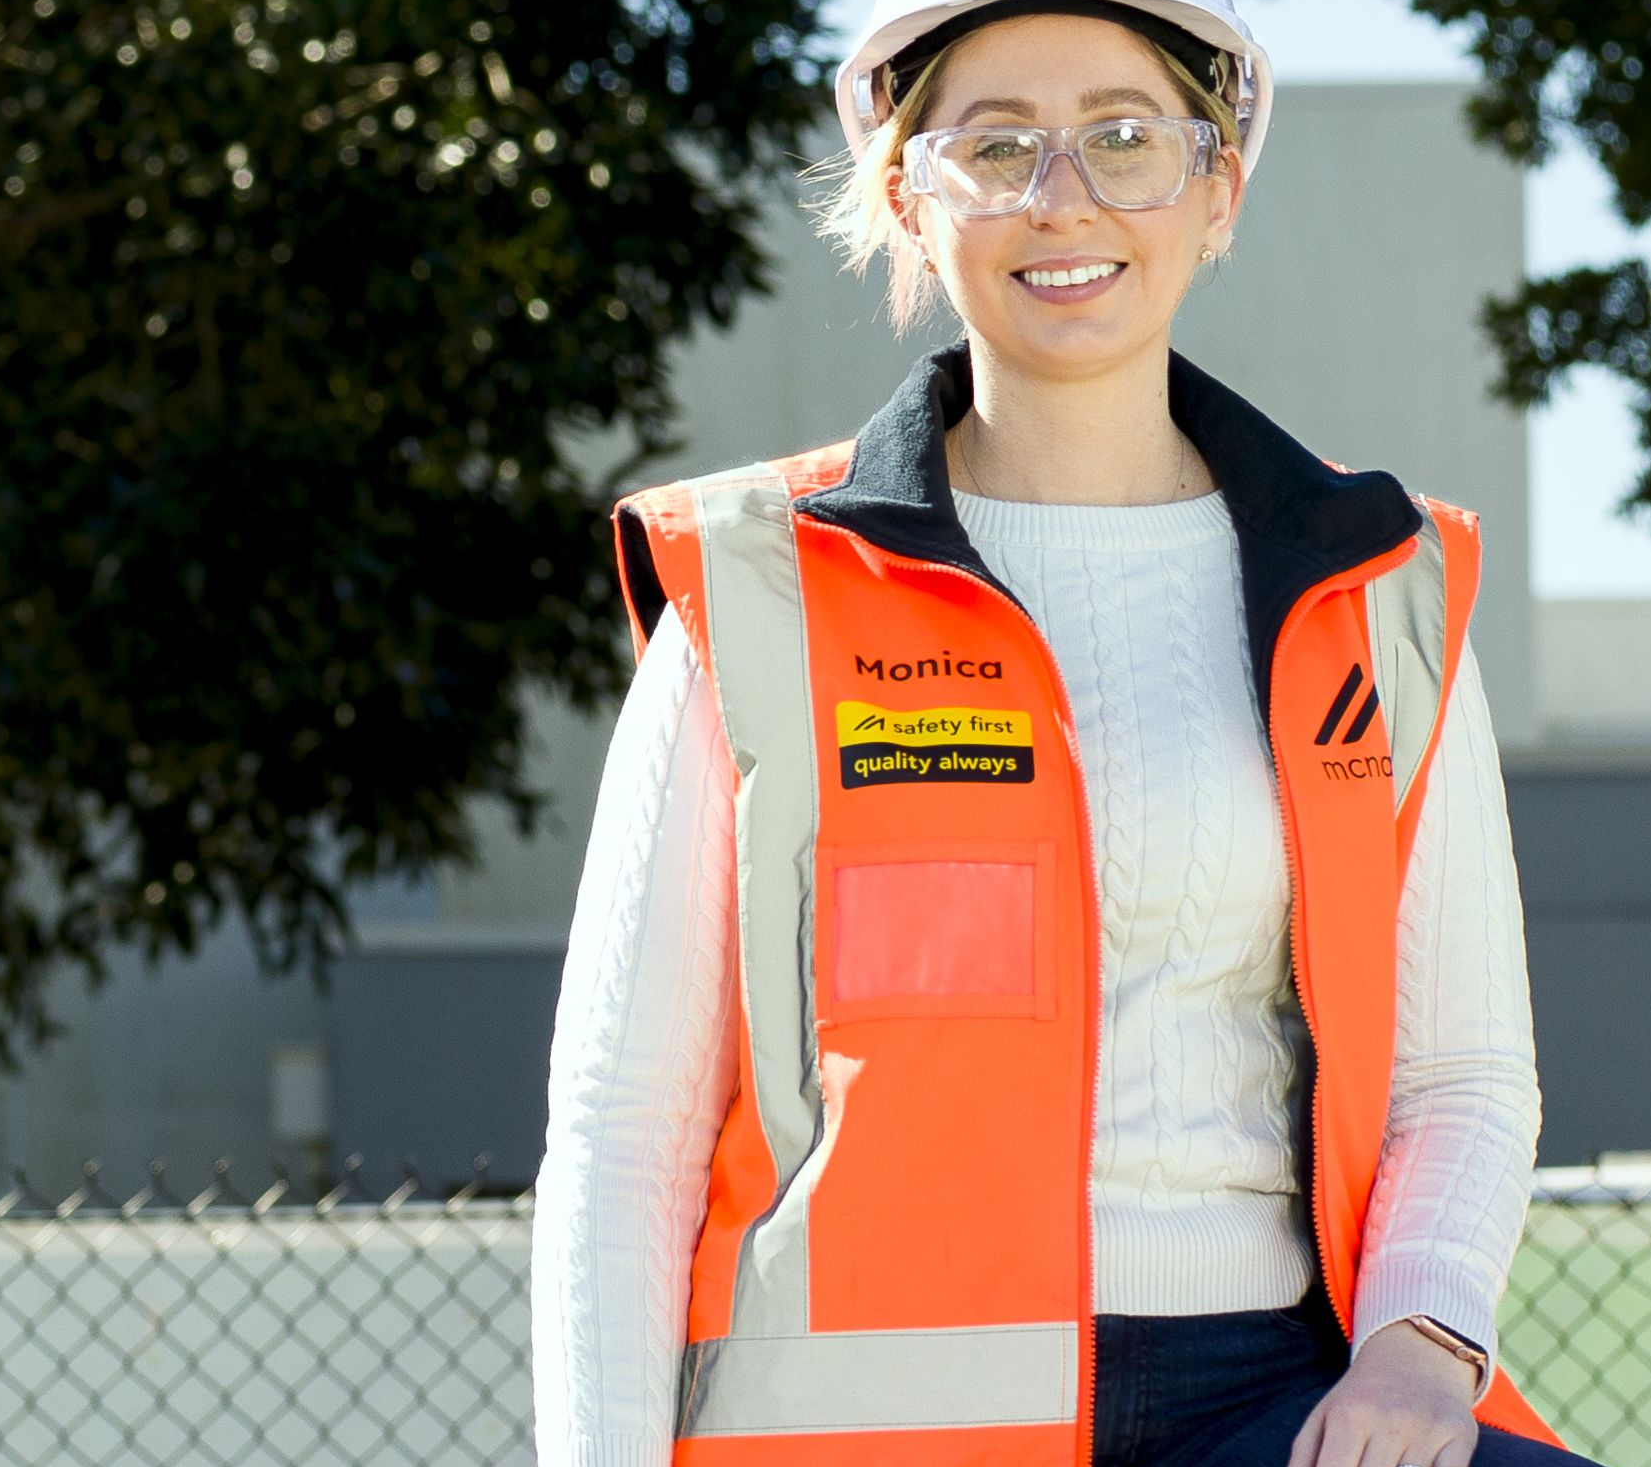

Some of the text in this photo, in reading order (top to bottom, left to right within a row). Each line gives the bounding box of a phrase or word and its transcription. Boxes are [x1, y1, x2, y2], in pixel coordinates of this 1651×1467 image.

[854, 650, 1002, 682] Monica
[893, 716, 1014, 736] safety first
[854, 750, 1017, 778] quality always
[1321, 755, 1394, 780] mcna
